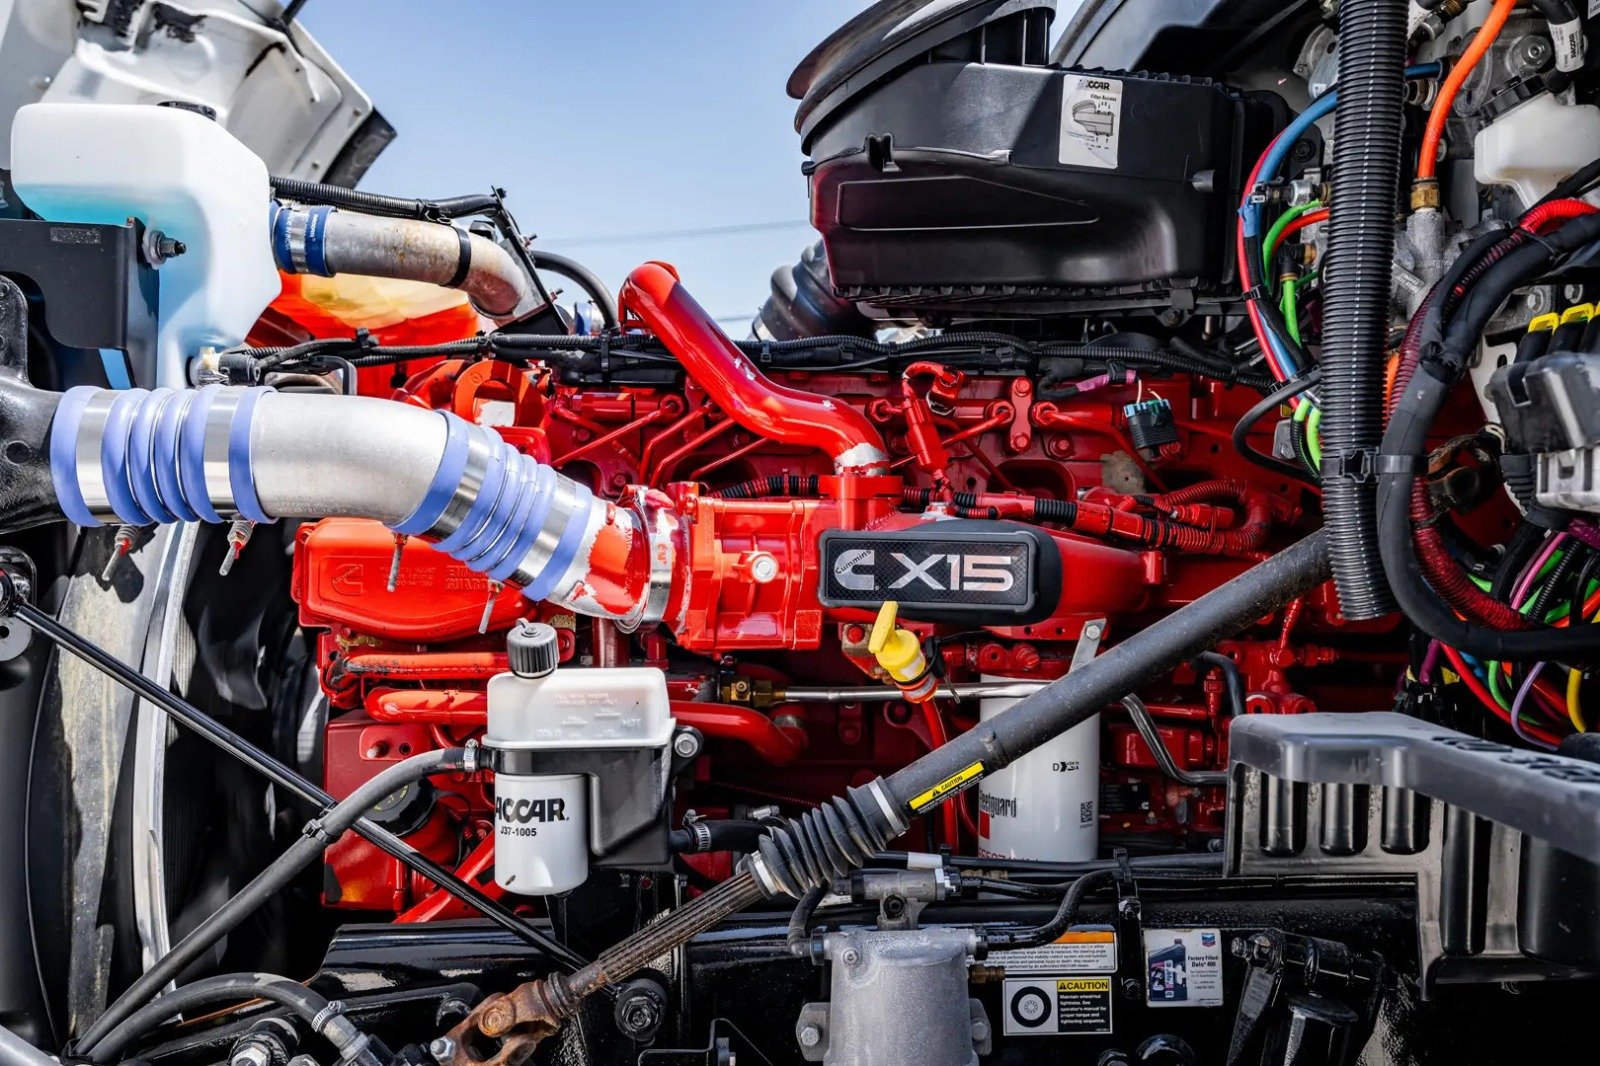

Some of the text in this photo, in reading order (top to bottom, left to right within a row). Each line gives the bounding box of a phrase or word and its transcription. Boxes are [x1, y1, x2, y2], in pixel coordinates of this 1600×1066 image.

[835, 549, 872, 575] Cummins
[941, 775, 963, 791] CAUTION
[495, 796, 566, 824] ACCAR
[500, 826, 537, 837] J37-1005
[1067, 981, 1108, 990] CAUTION
